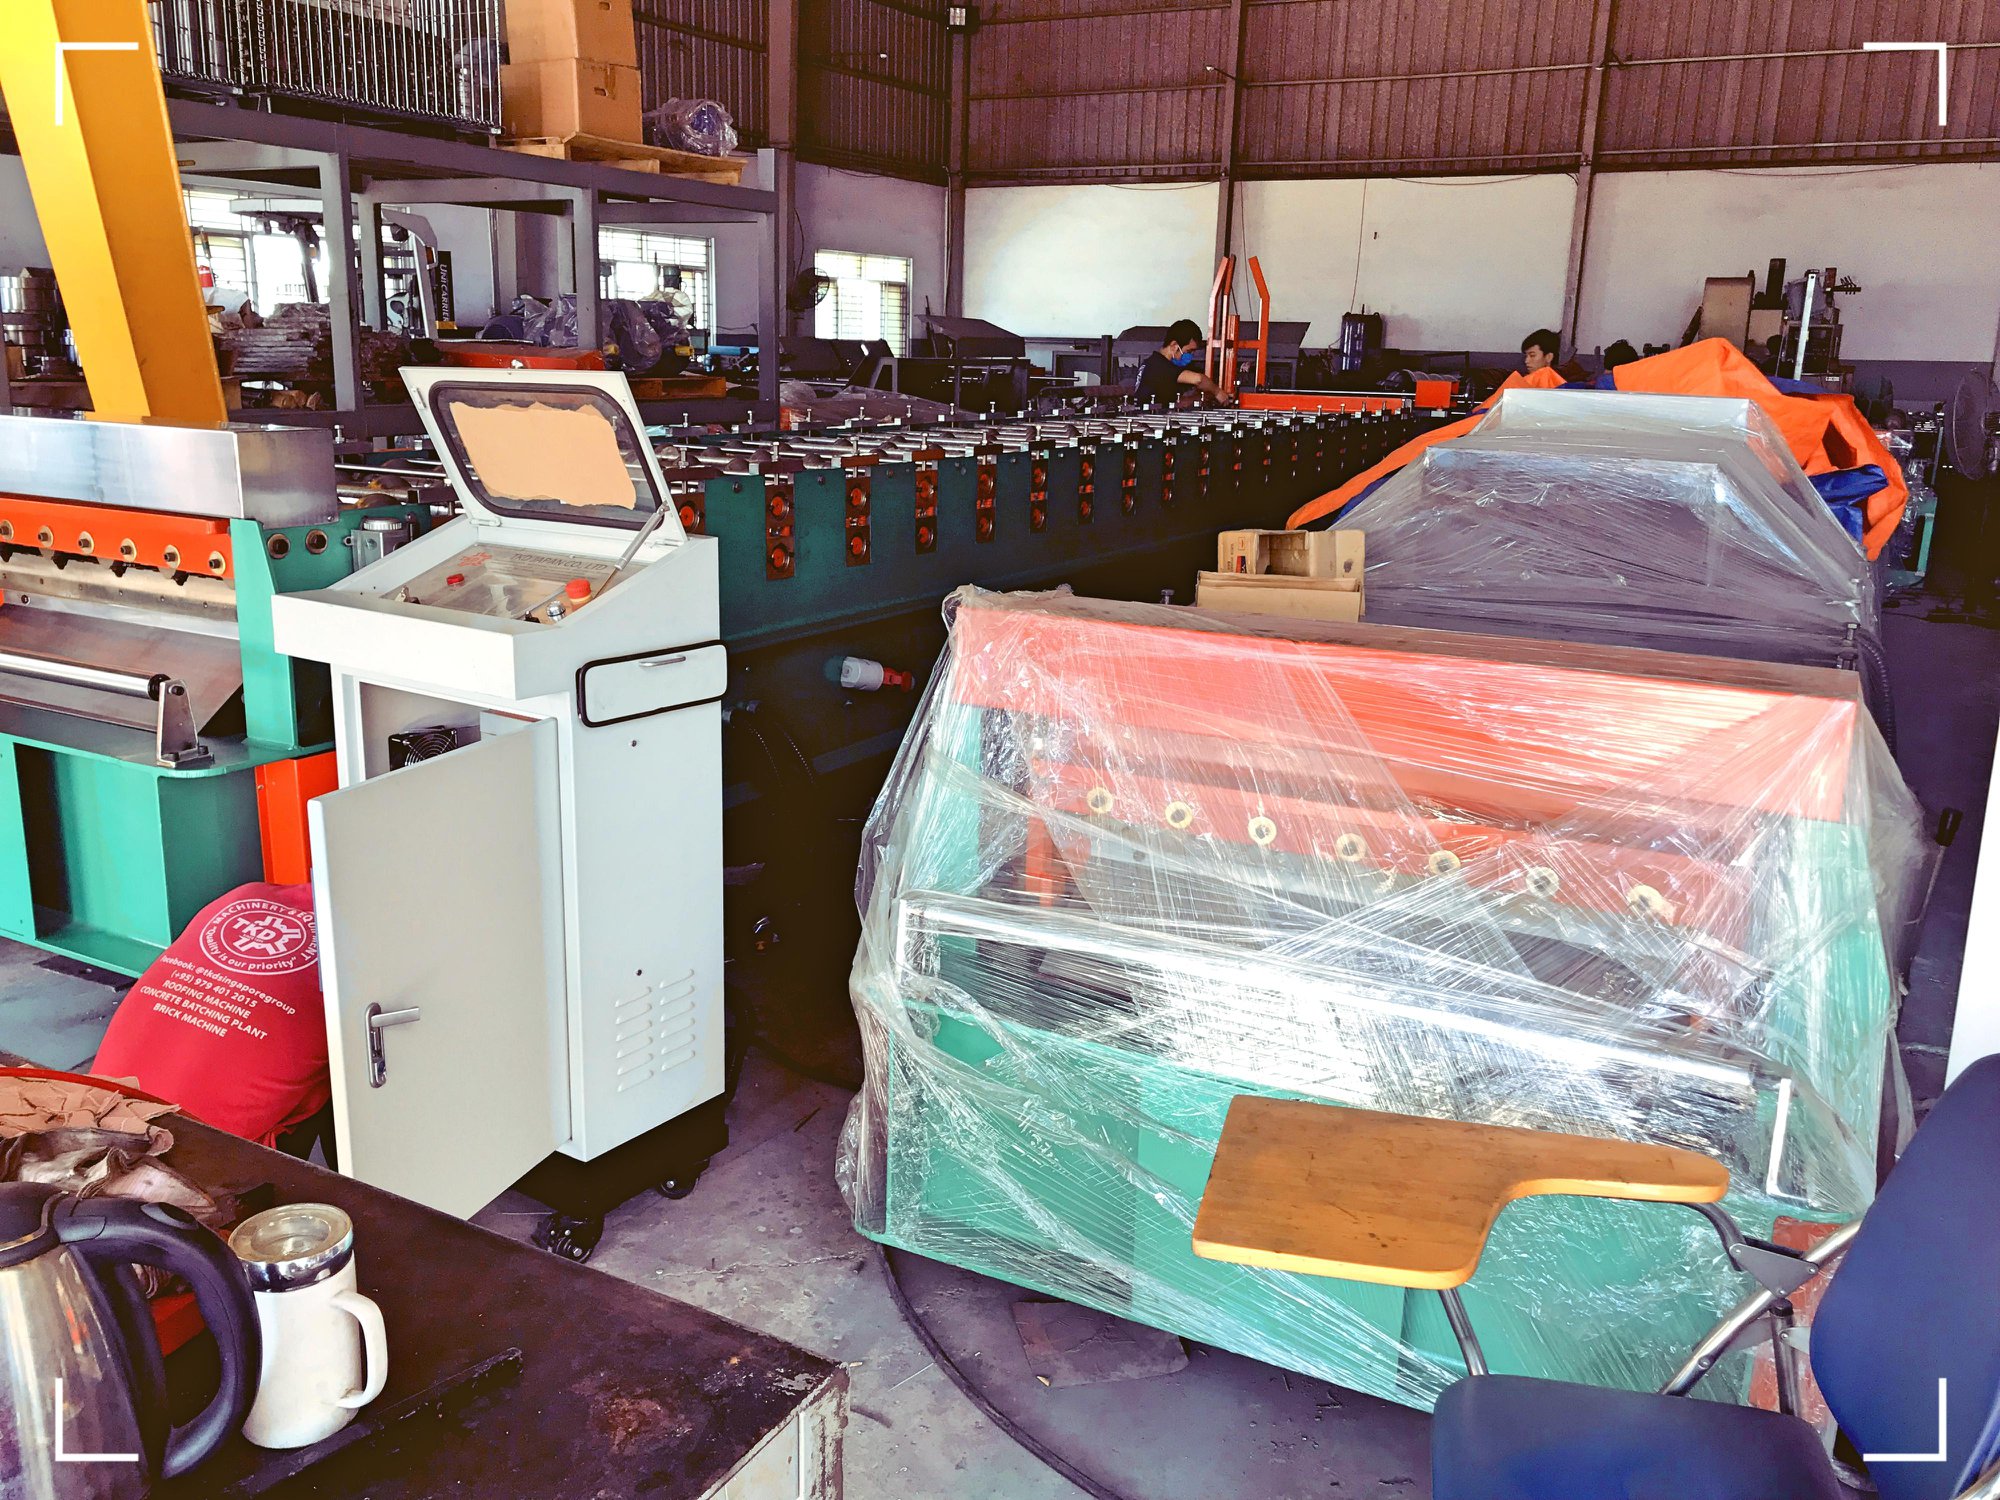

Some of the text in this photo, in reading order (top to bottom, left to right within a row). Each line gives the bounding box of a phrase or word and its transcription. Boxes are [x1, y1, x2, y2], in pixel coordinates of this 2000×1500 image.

[510, 553, 532, 562] TKD
[529, 555, 564, 567] JAPAN
[213, 902, 285, 925] MACHINERY
[232, 917, 276, 940] TKD
[218, 952, 228, 961] is
[228, 959, 247, 968] our
[160, 955, 296, 1015] facebook: @tkdsingaporegroup
[162, 980, 251, 1019] ROOFING MACHINE
[171, 969, 258, 1008] (+95) 979 401 2015
[140, 985, 267, 1040] CONCRETE BATCHING PLANT
[152, 1002, 228, 1038] BRICK MACHINE
